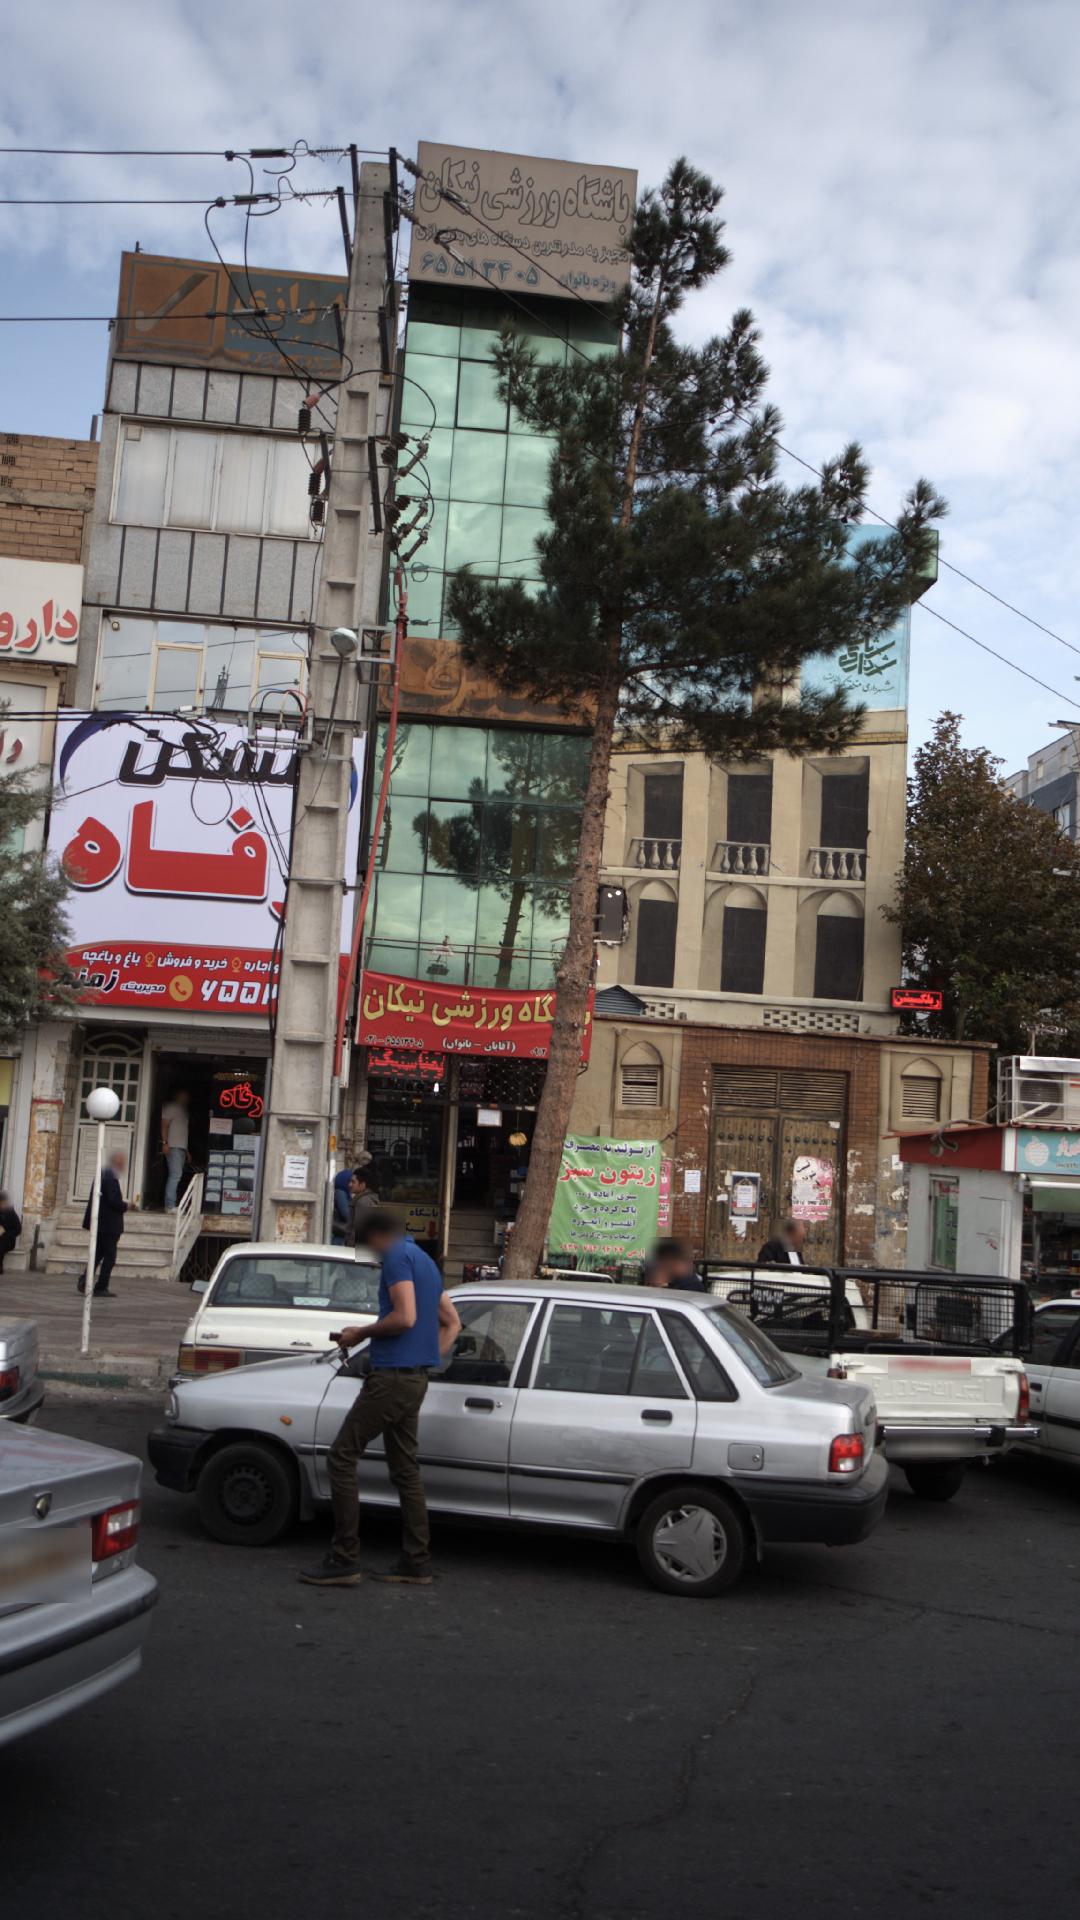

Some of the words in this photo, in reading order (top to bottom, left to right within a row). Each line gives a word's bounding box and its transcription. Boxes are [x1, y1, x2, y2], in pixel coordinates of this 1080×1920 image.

[481, 167, 560, 229] ورزشی
[563, 174, 630, 236] باشگاه
[467, 231, 490, 248] های
[490, 231, 530, 249] دستگاه
[119, 731, 298, 788] سکن
[82, 950, 113, 966] باغچه
[114, 955, 121, 965] و
[123, 952, 141, 968] باغ
[157, 951, 192, 969] فروش
[194, 959, 201, 970] و
[203, 957, 228, 970] خرید
[244, 960, 272, 975] اجاره
[363, 983, 425, 1022] نیکان
[431, 990, 513, 1031] ورزشی
[220, 1081, 264, 1118] رفاه
[564, 1137, 600, 1153] مصرف
[602, 1143, 612, 1153] به
[614, 1143, 644, 1157] تولید
[645, 1144, 655, 1158] از
[560, 1160, 595, 1182] سبز
[600, 1163, 656, 1186] زیتون
